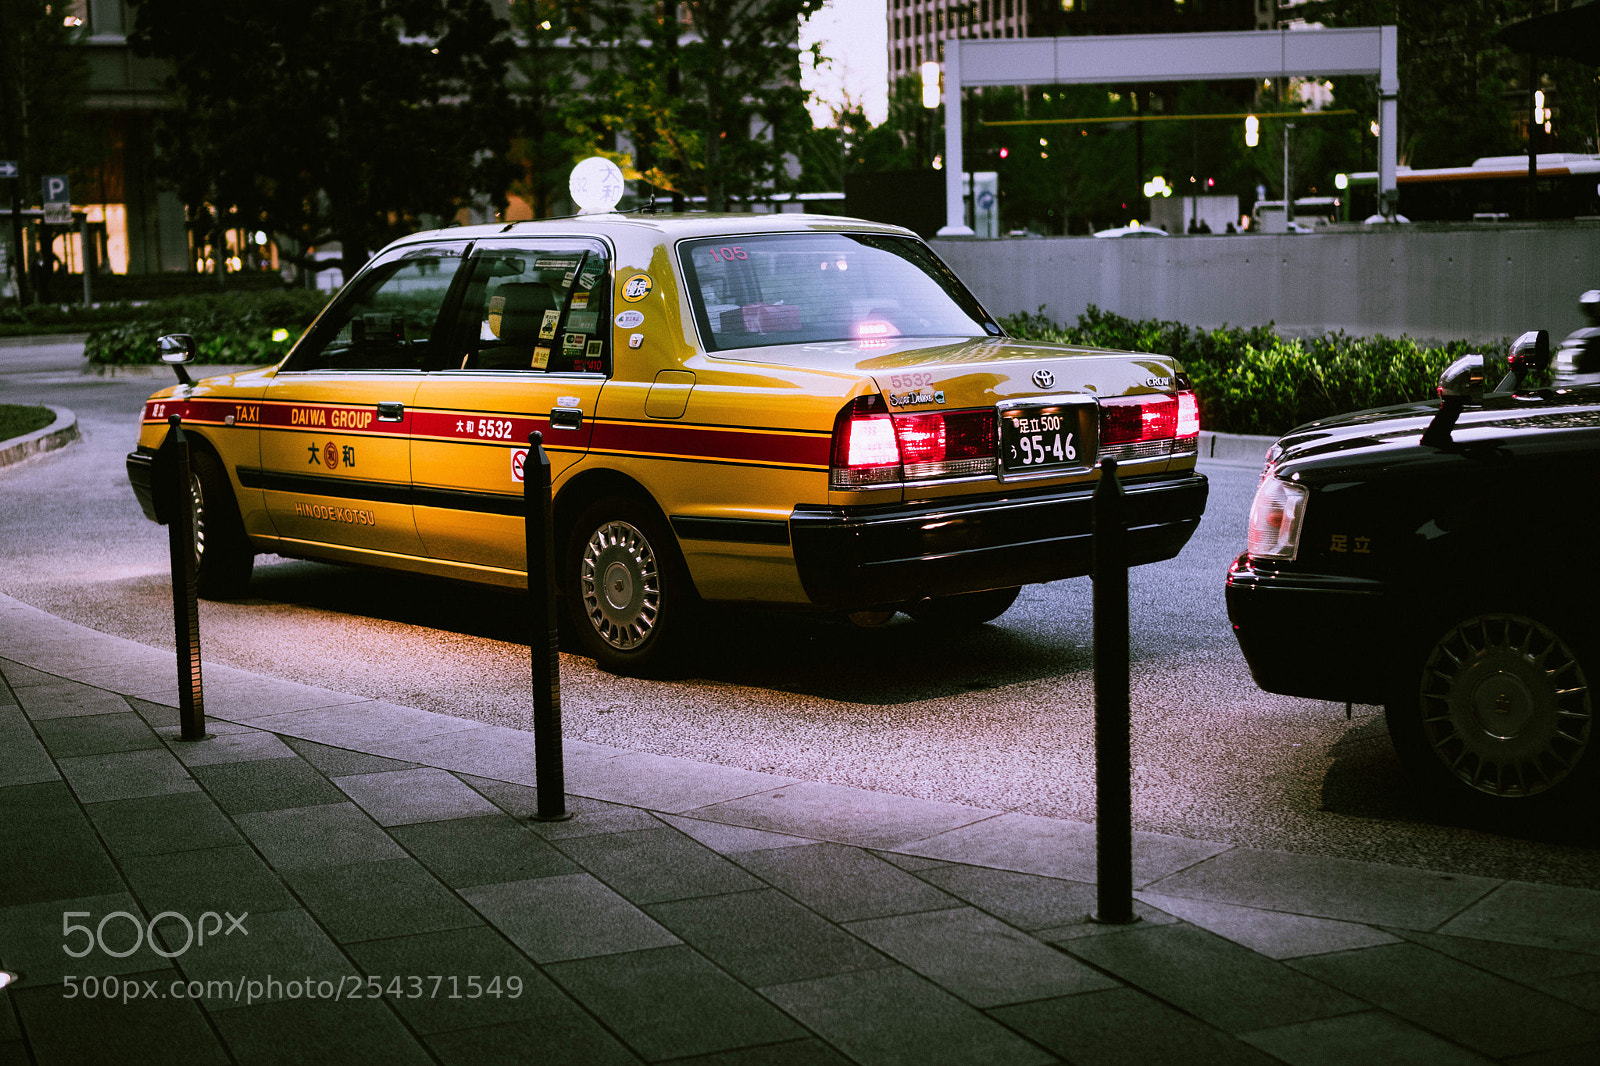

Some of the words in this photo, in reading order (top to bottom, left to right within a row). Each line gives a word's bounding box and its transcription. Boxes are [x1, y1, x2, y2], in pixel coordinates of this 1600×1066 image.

[49, 177, 65, 200] P
[600, 163, 620, 203] 大和
[709, 246, 748, 263] 105
[890, 372, 934, 389] 5532
[1146, 376, 1174, 387] CROWN
[235, 405, 260, 423] TAXI
[291, 408, 326, 426] DAIWA
[331, 411, 372, 429] GROUP
[455, 419, 475, 434] 大和
[477, 418, 513, 439] 5532
[1019, 418, 1041, 434] 足立
[1040, 416, 1061, 432] 500
[1019, 432, 1077, 465] 95-46
[1328, 533, 1372, 555] 足立
